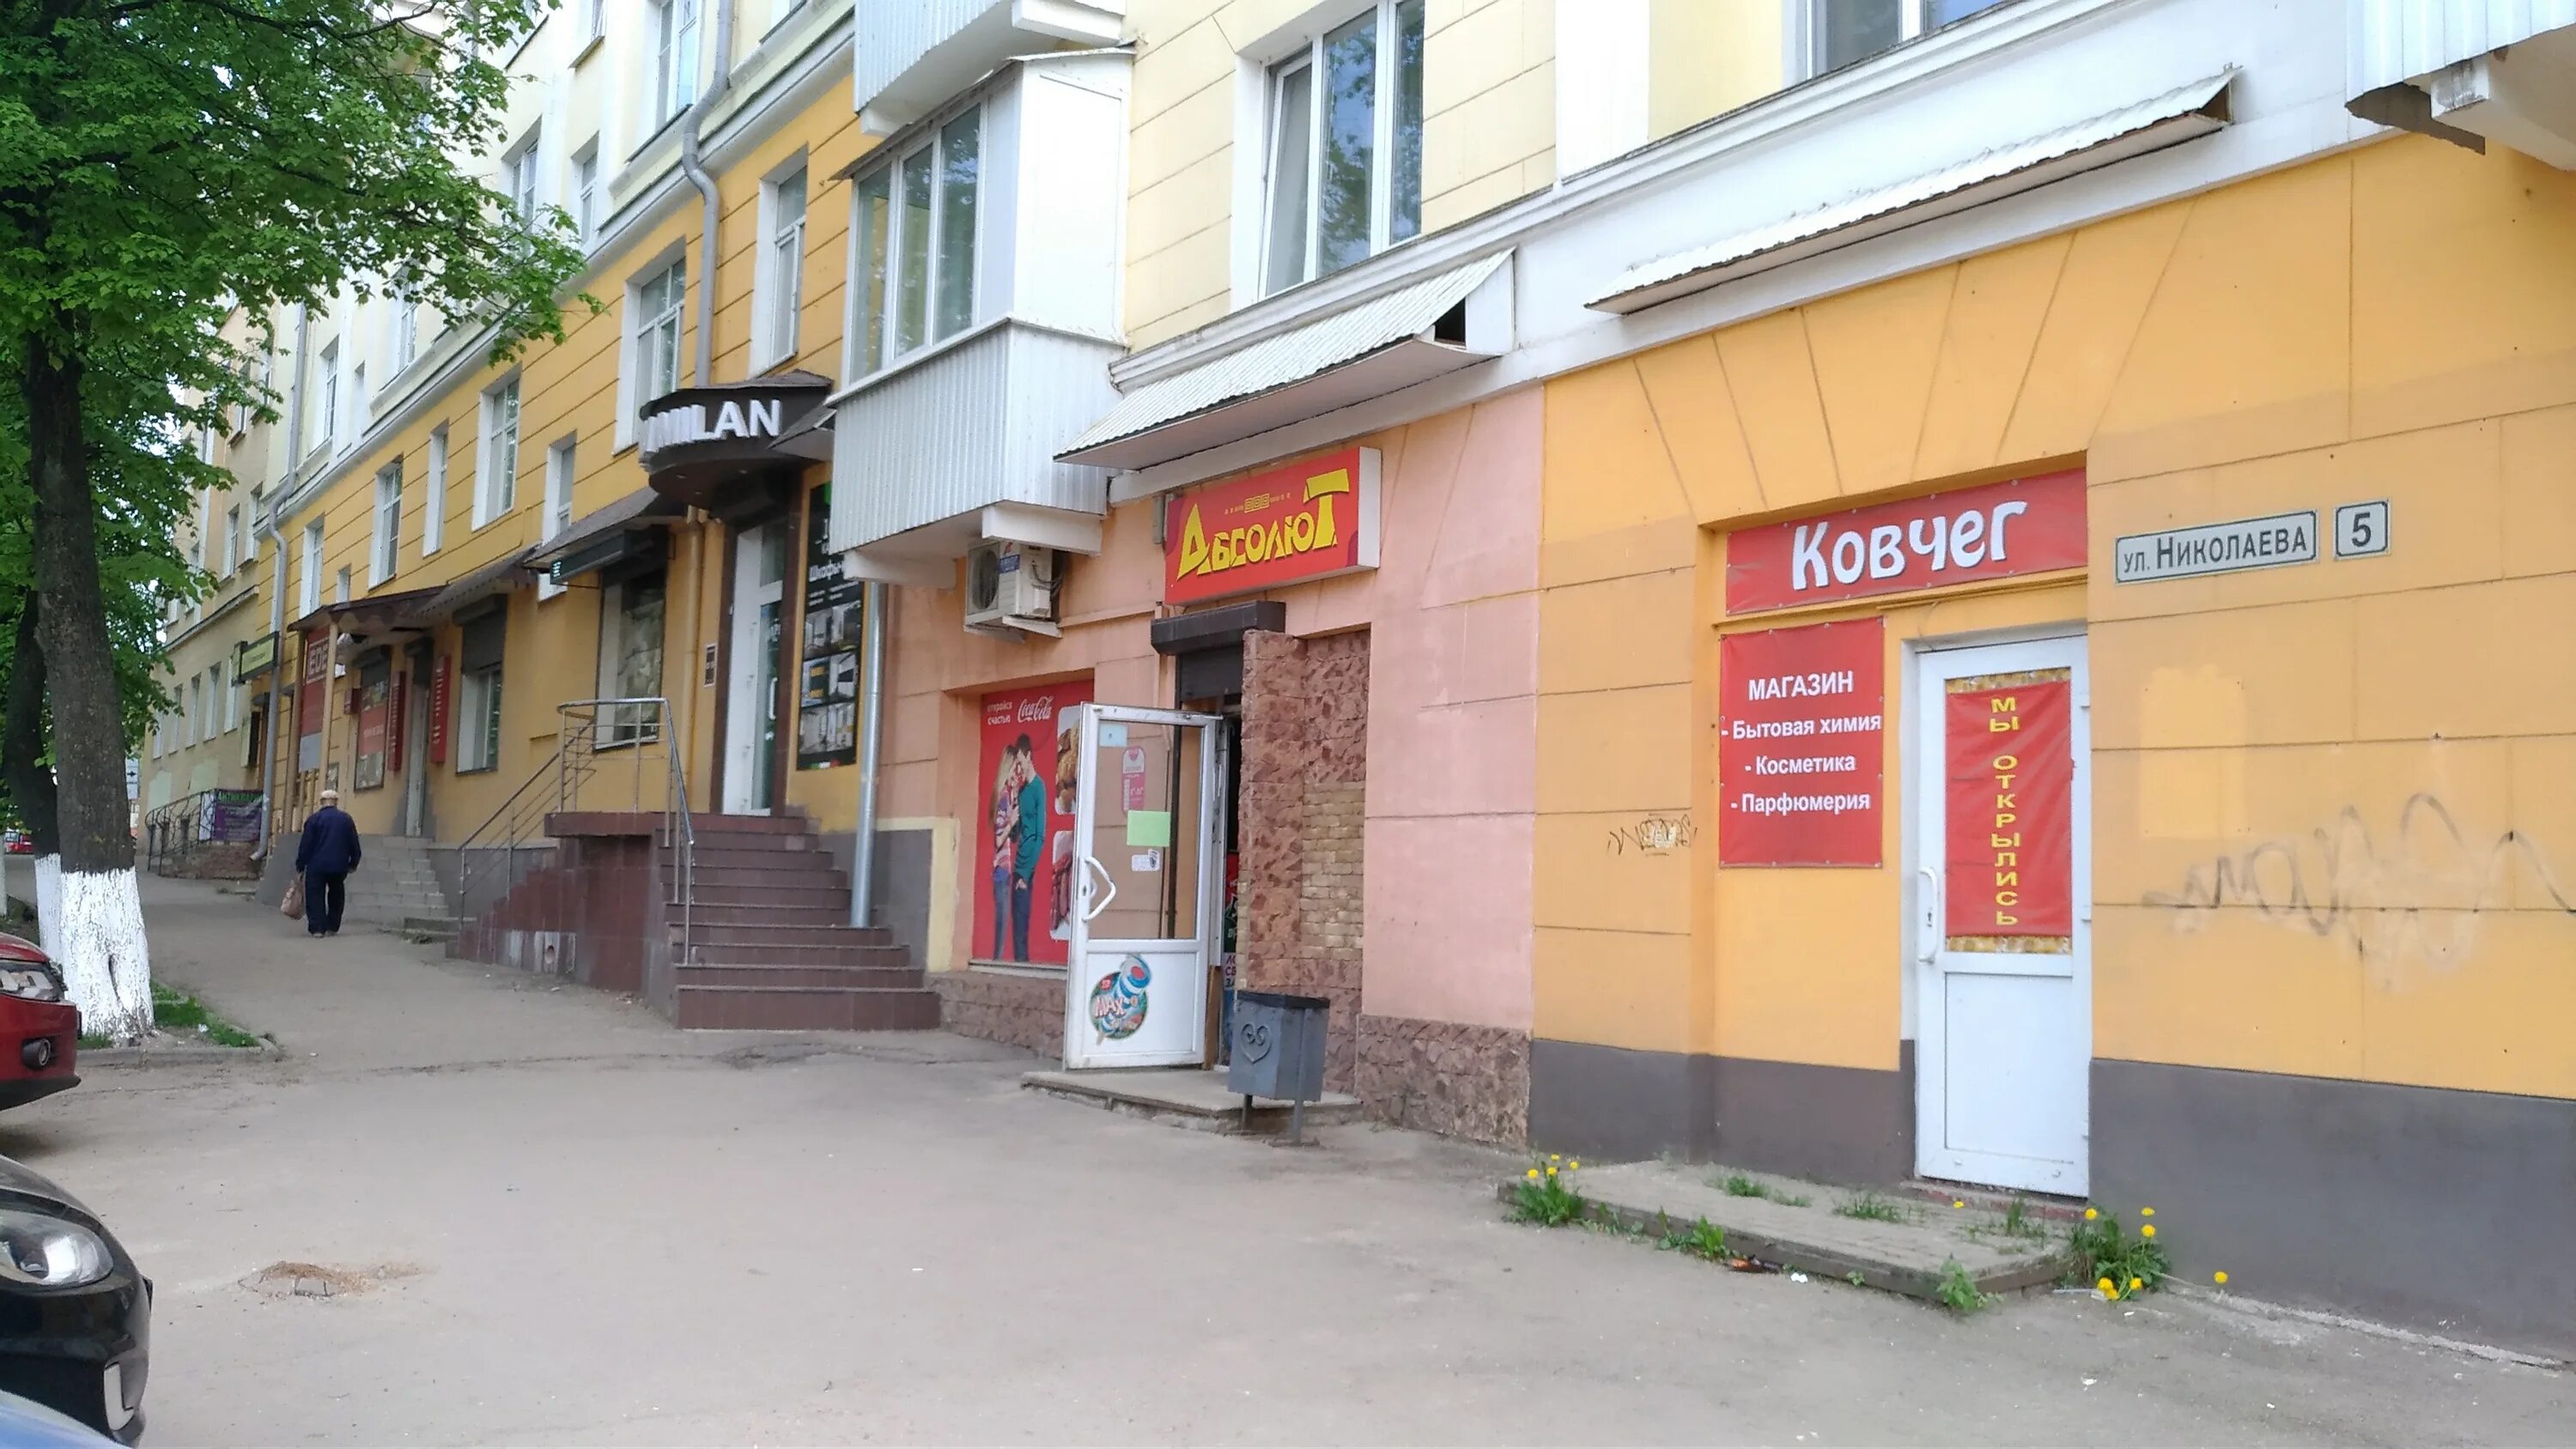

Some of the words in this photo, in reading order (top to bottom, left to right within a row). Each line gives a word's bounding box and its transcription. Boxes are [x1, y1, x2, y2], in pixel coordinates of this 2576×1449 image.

[1791, 500, 2028, 591] Ковчег
[2351, 512, 2372, 548] 5
[2156, 524, 2308, 569] НИКОЛАЕВА
[1748, 670, 1854, 701] МАГАЗИН
[1733, 719, 1815, 740] Бытовая
[1820, 714, 1882, 734] химия
[1756, 755, 1856, 776] Косметика
[1741, 791, 1871, 816] Парфюмерия
